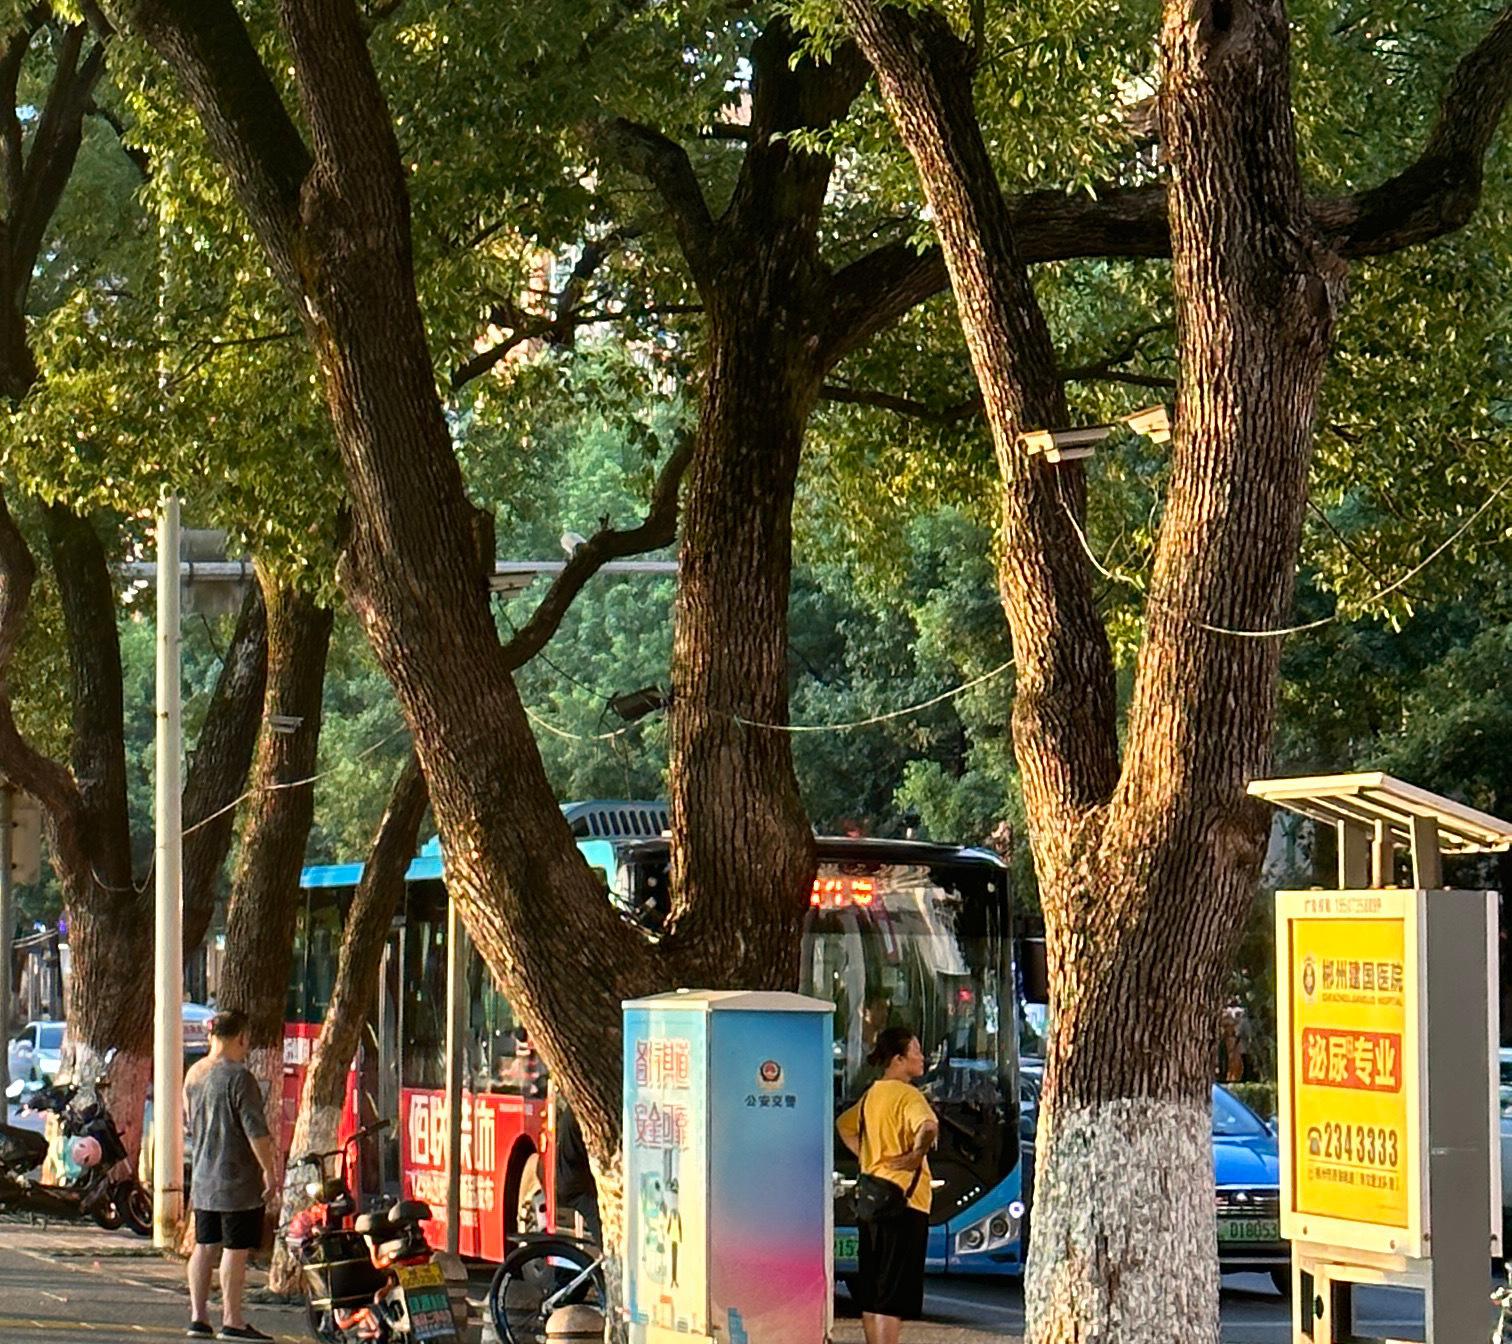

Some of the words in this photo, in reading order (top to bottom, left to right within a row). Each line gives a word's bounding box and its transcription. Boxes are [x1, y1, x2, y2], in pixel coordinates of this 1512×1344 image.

[1308, 1034, 1396, 1087] 泌尿专业
[744, 1094, 797, 1109] 公安交警
[1324, 1121, 1399, 1168] 2343333
